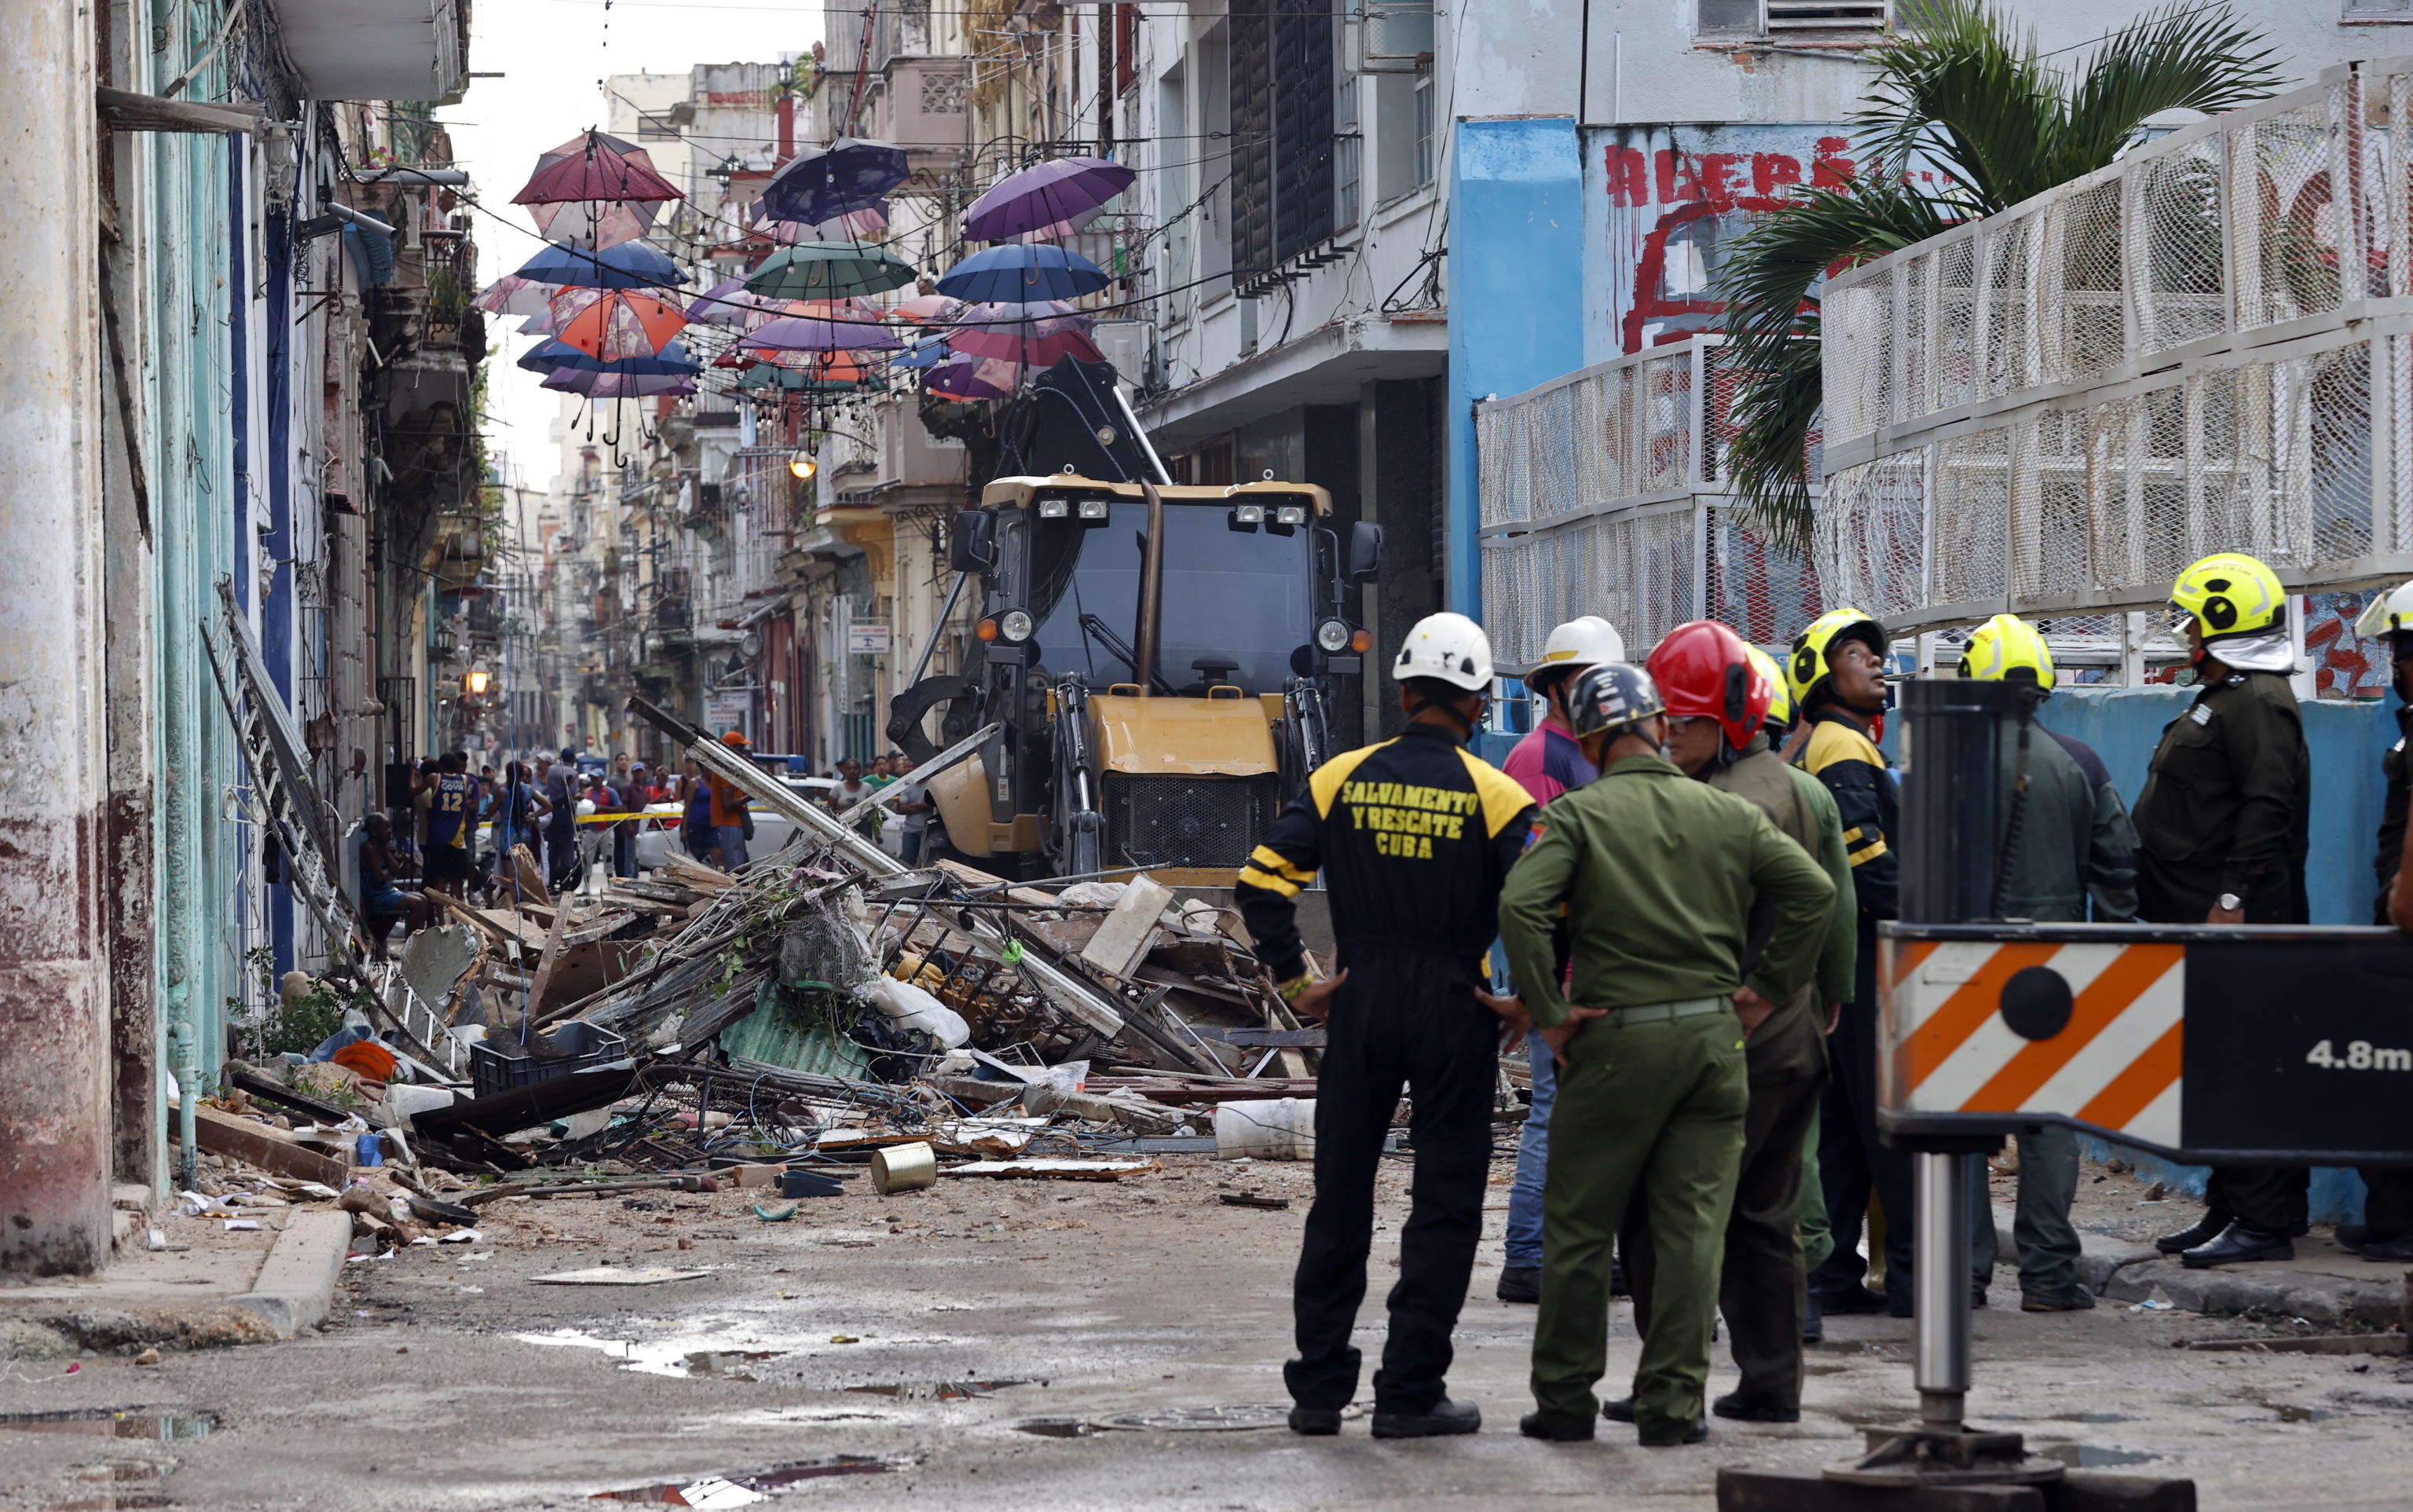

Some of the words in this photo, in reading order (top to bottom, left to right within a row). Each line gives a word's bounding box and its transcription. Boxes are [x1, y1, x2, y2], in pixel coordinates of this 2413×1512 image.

[441, 792, 463, 811] 12
[1342, 781, 1478, 815] SALVAMENTO
[1352, 806, 1365, 829] Y
[1368, 806, 1464, 840] RESCATE
[1375, 832, 1433, 859] CUBA
[2305, 1038, 2413, 1071] 4.8m
